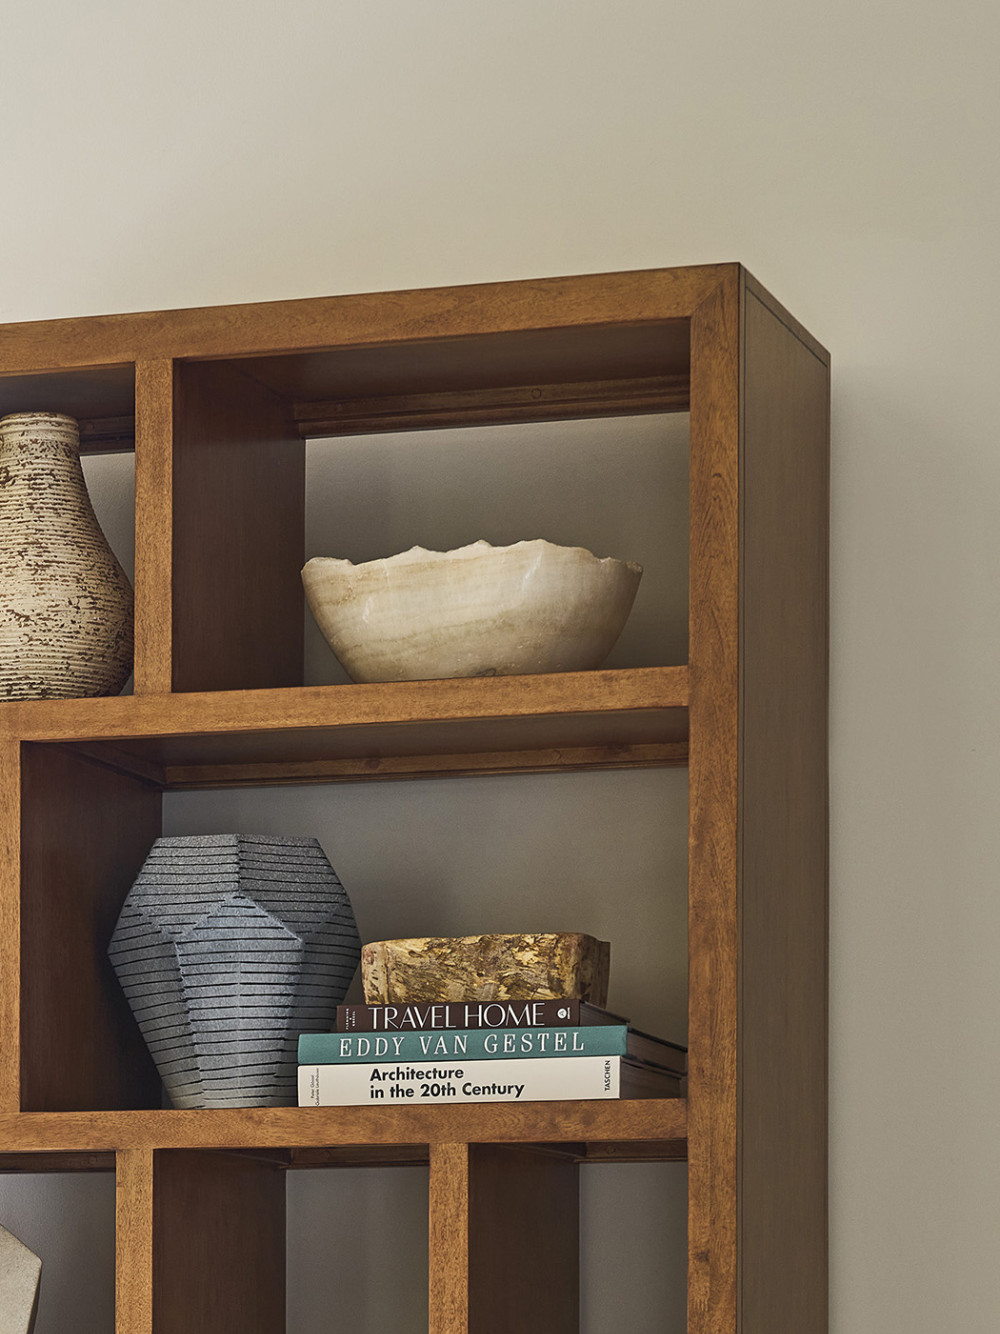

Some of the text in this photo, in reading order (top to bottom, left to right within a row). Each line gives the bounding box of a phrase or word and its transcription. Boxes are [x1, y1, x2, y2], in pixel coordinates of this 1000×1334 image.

[368, 1005, 457, 1030] TRAVEL
[464, 1002, 545, 1027] HOME
[339, 1031, 585, 1057] EDDY VAN GESTEL
[370, 1067, 464, 1081] Architecture
[370, 1082, 525, 1099] in the 20th Century
